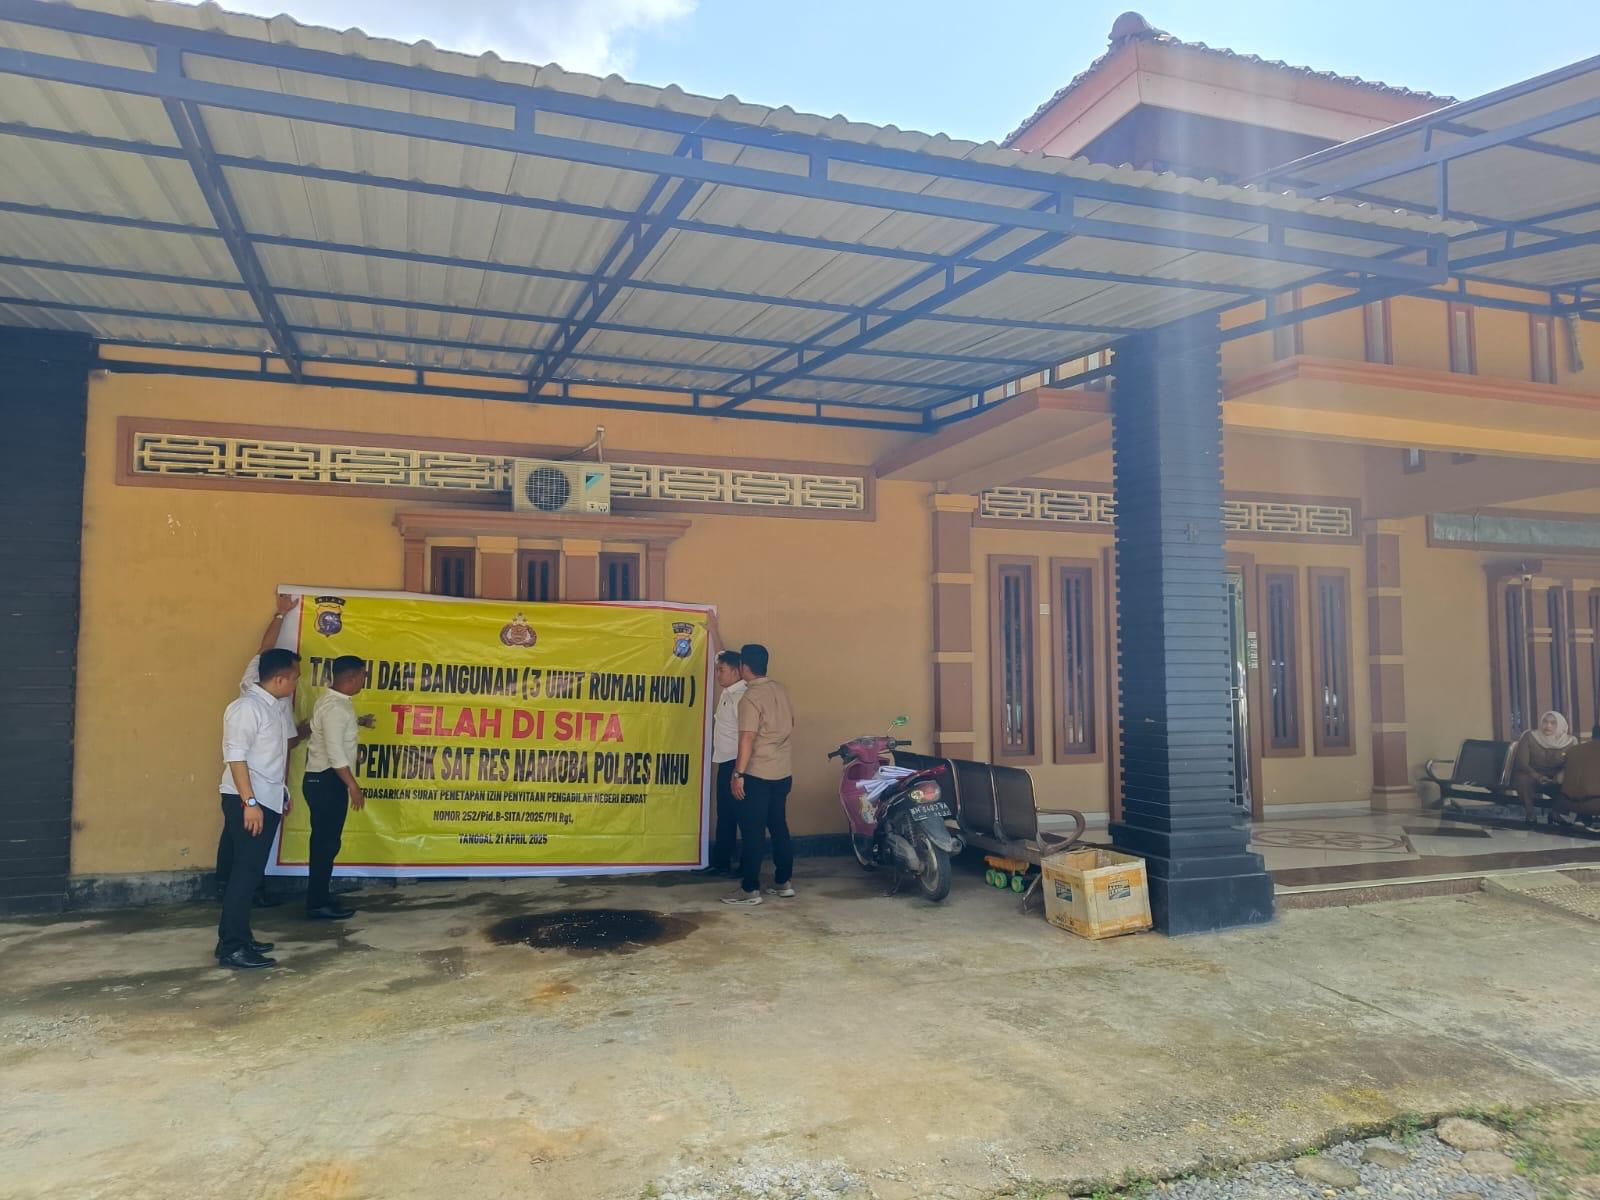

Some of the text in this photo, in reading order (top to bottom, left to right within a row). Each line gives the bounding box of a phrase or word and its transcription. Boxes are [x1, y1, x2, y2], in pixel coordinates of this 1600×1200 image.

[310, 656, 373, 690] TAH
[377, 660, 416, 692] DAN
[420, 663, 518, 698] BANGUNAN
[522, 666, 542, 700] (3
[545, 670, 585, 700] UNIT
[589, 672, 646, 703] RUMAH
[650, 675, 685, 704] HUNI
[391, 704, 624, 742] TELAH DI SITA
[355, 744, 690, 785] PENYIDIK SAT RES NARKOBA POLRES INHU
[360, 787, 648, 804] RDASARKAN SURAT PENETAPAN IZIN PENYITAAN PENGADILAN NEGERI RENGAT
[433, 810, 461, 821] NOMOR
[462, 810, 558, 824] 252/Pid.B-SITA/2025/PN
[459, 833, 548, 845] TANGGAL 21 APRIL 2025
